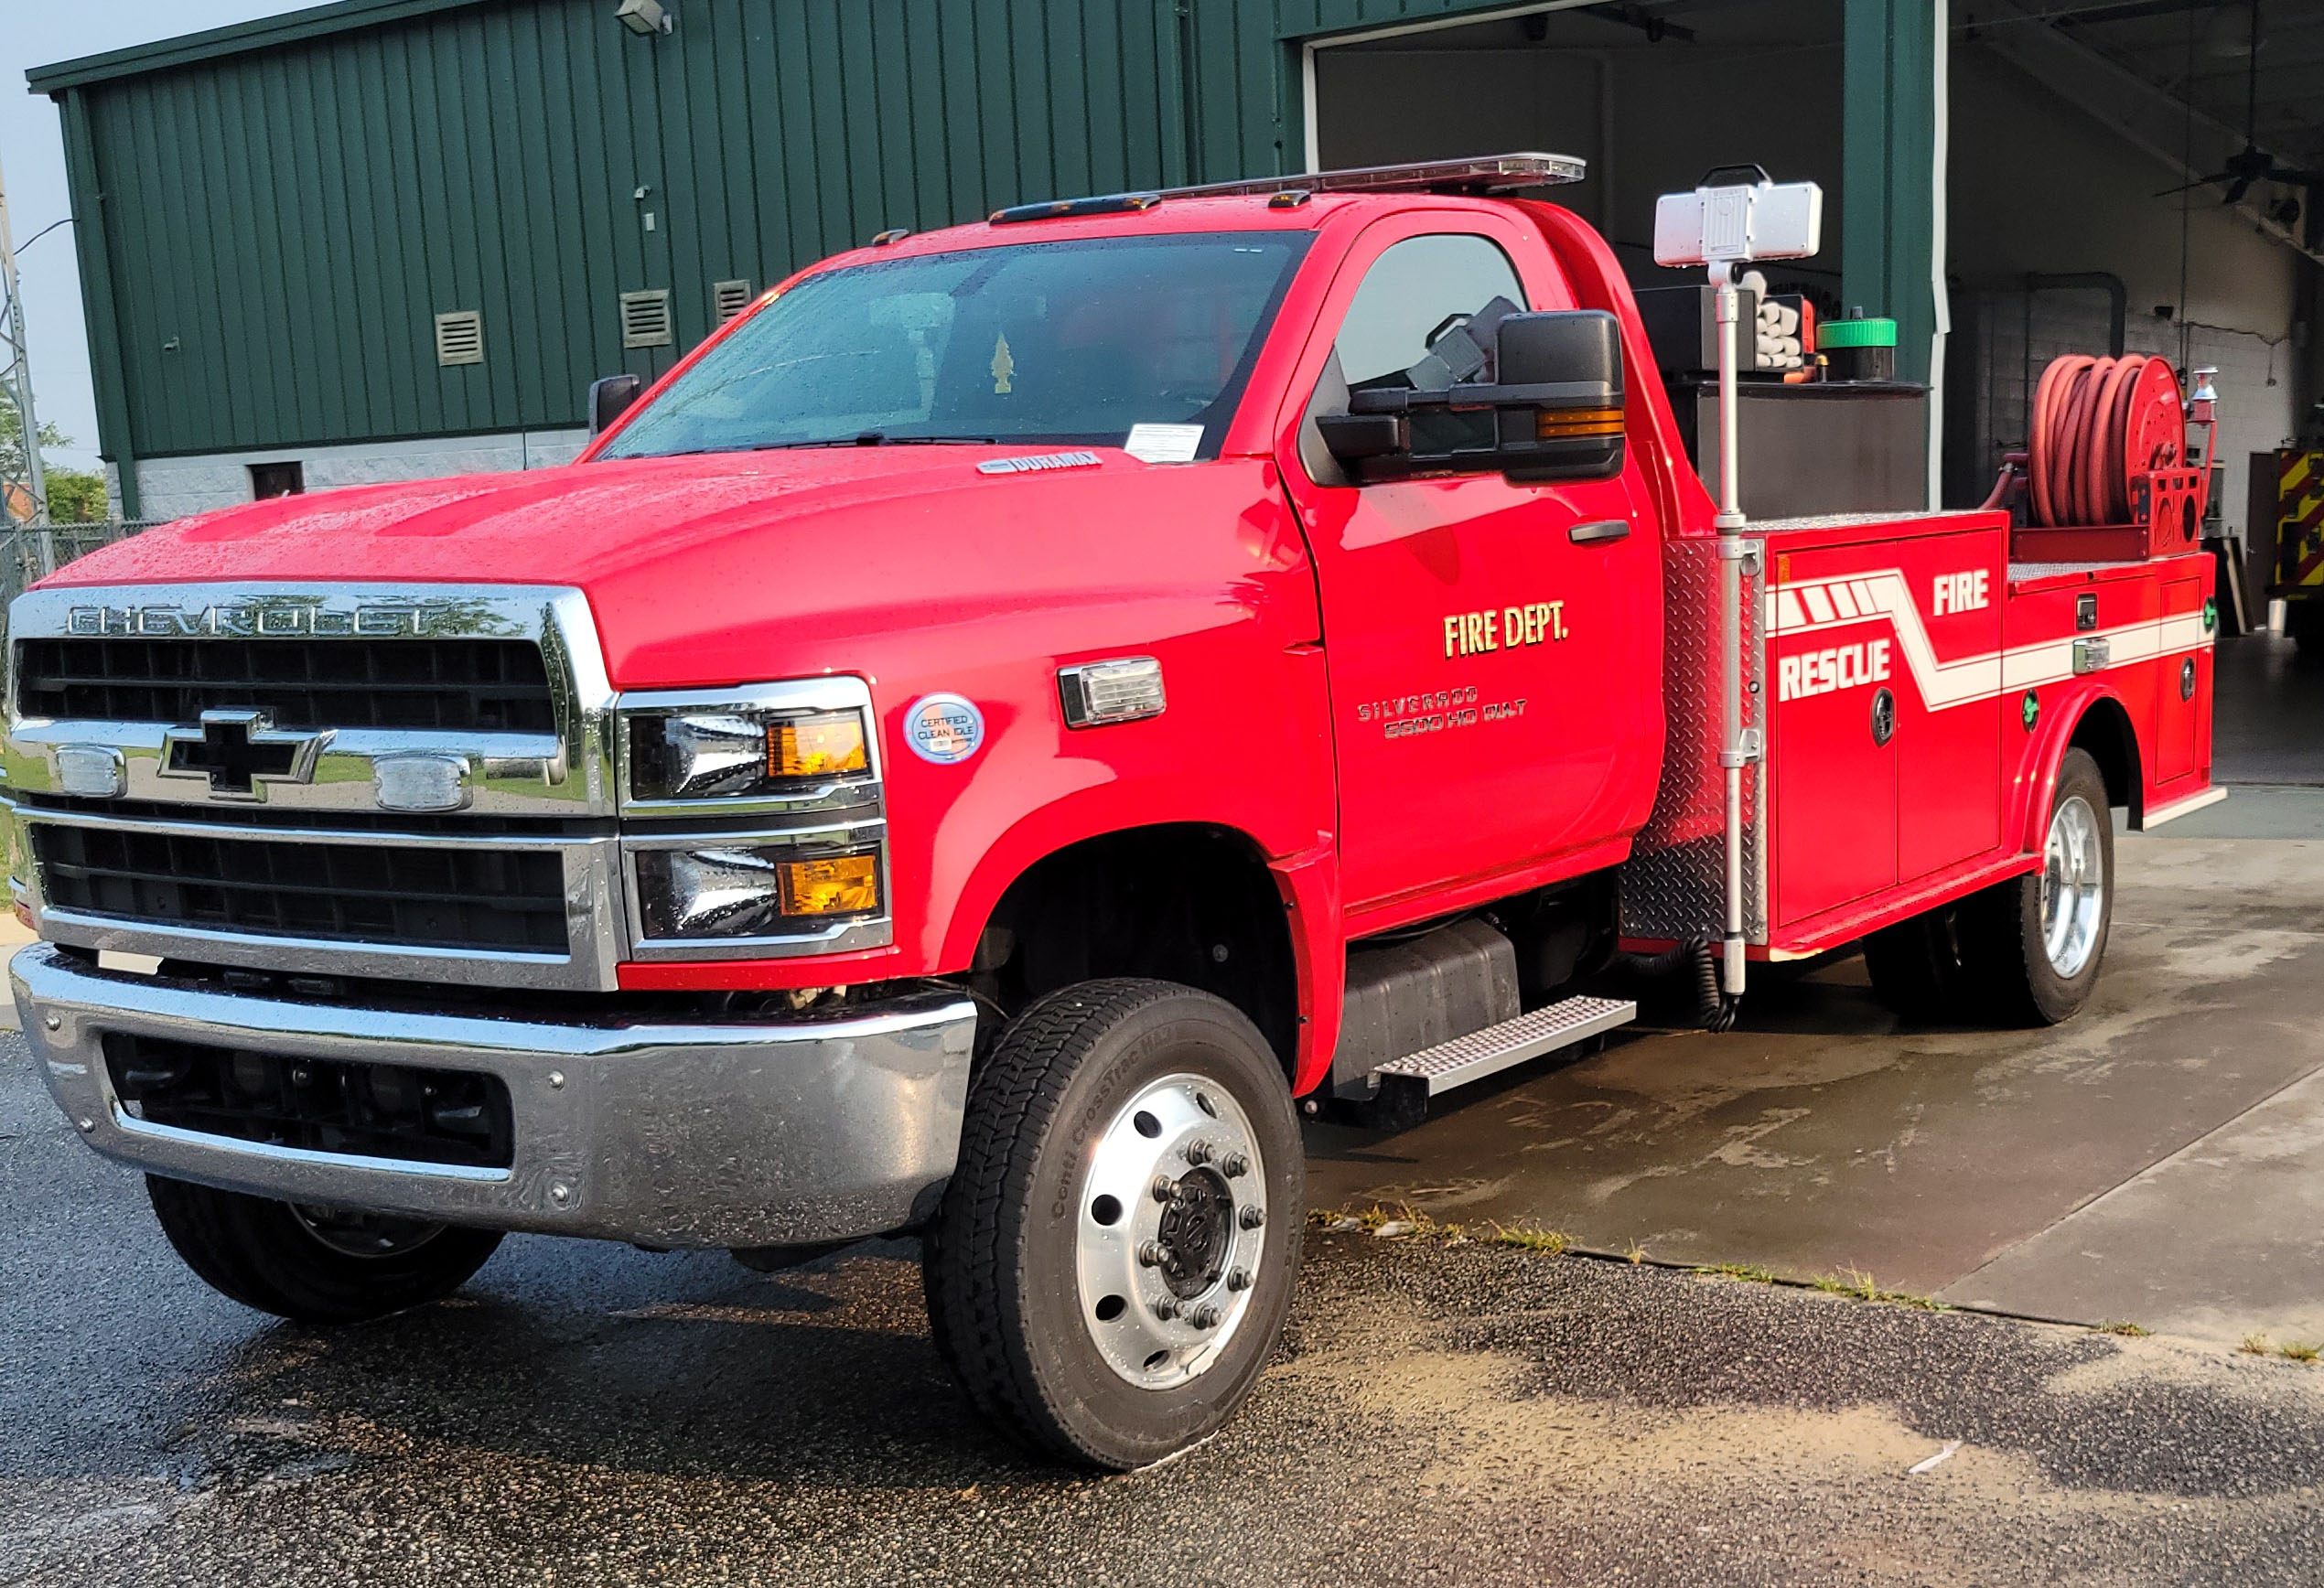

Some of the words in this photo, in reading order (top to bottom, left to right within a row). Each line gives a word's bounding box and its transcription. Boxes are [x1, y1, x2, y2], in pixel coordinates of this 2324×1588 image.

[1933, 568, 1989, 617] FIRE
[68, 605, 437, 636] CHEVROLET
[1443, 609, 1499, 660] FIRE
[1503, 600, 1569, 650] DEPT.
[1779, 638, 1891, 703] RESCUE
[920, 715, 968, 728] CERTIFIED
[1358, 686, 1478, 722] SILVERADO
[918, 729, 950, 740] CLEAN
[953, 725, 974, 735] IDLE
